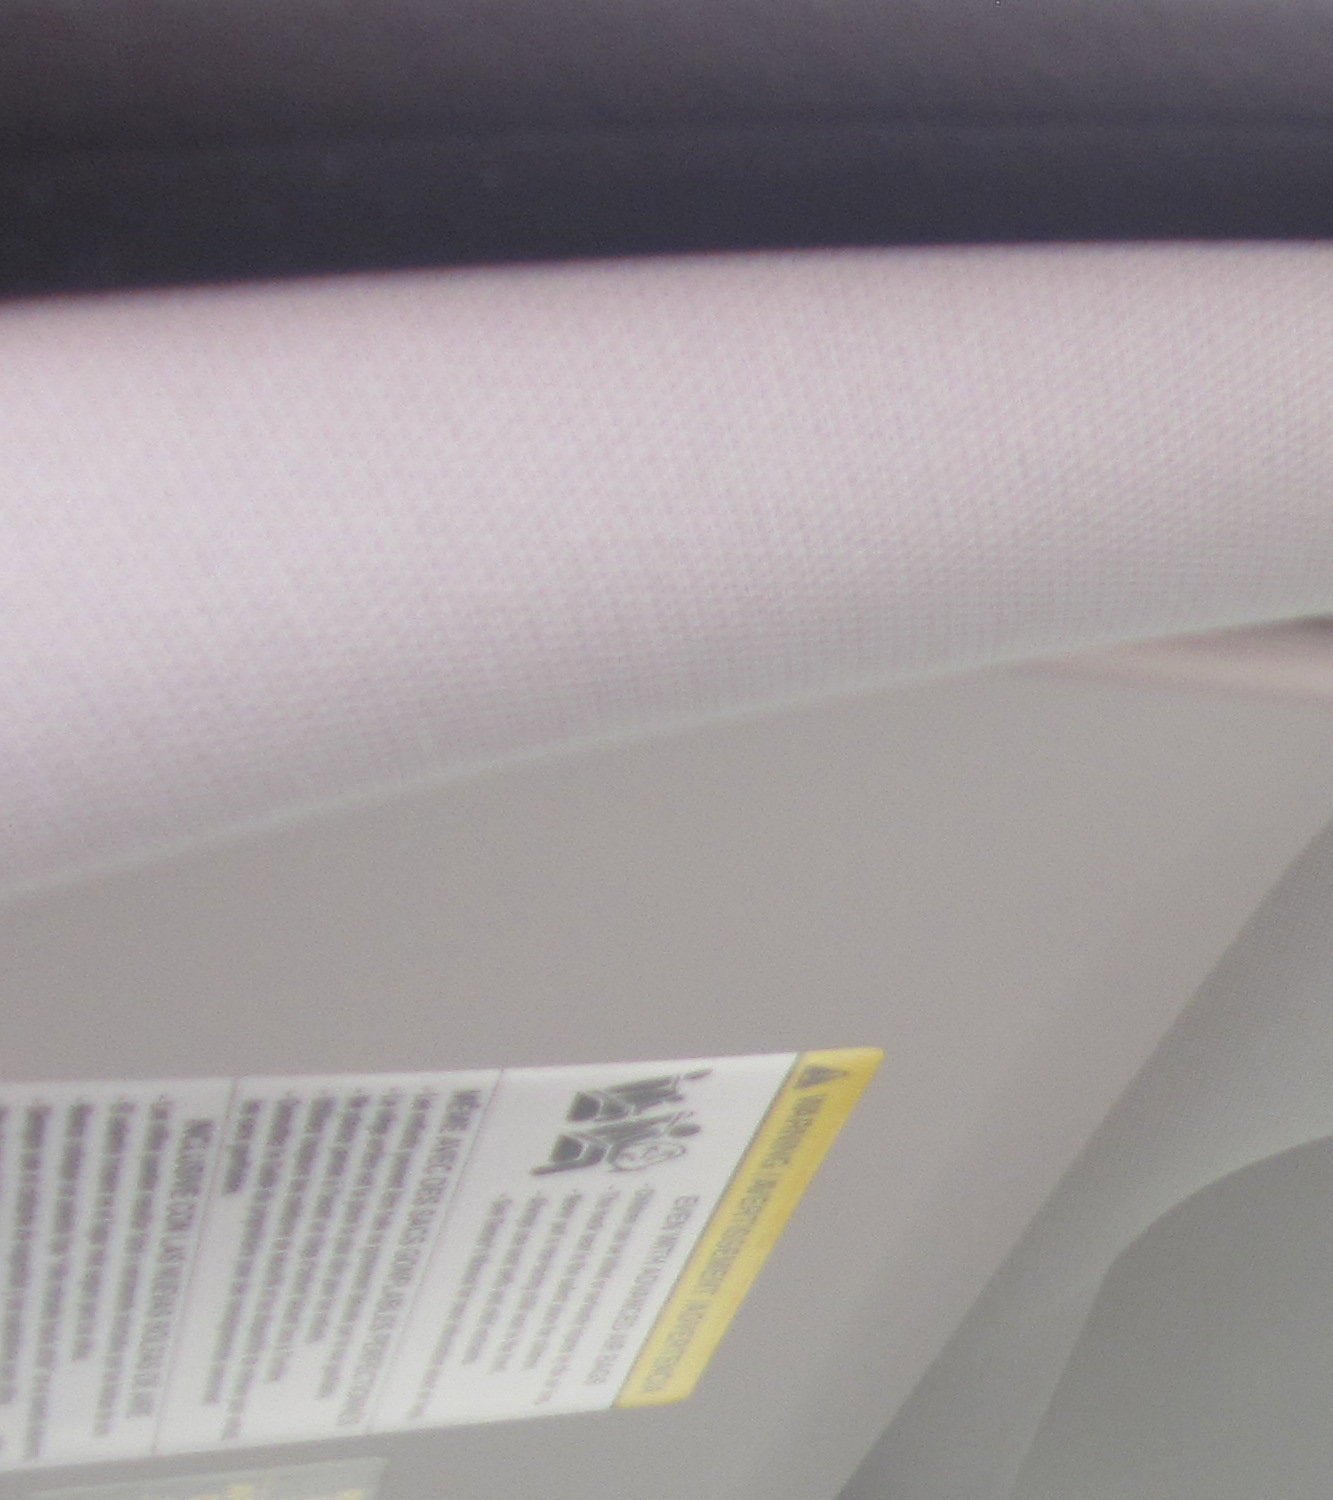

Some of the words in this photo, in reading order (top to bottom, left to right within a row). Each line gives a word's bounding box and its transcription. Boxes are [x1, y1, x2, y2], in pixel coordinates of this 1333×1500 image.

[759, 1093, 826, 1169] WARNING
[424, 1135, 465, 1173] AVEC
[412, 1176, 449, 1205] DES
[398, 1208, 437, 1245] SACS
[660, 1195, 700, 1230] EVEN
[642, 1233, 680, 1265] WITH
